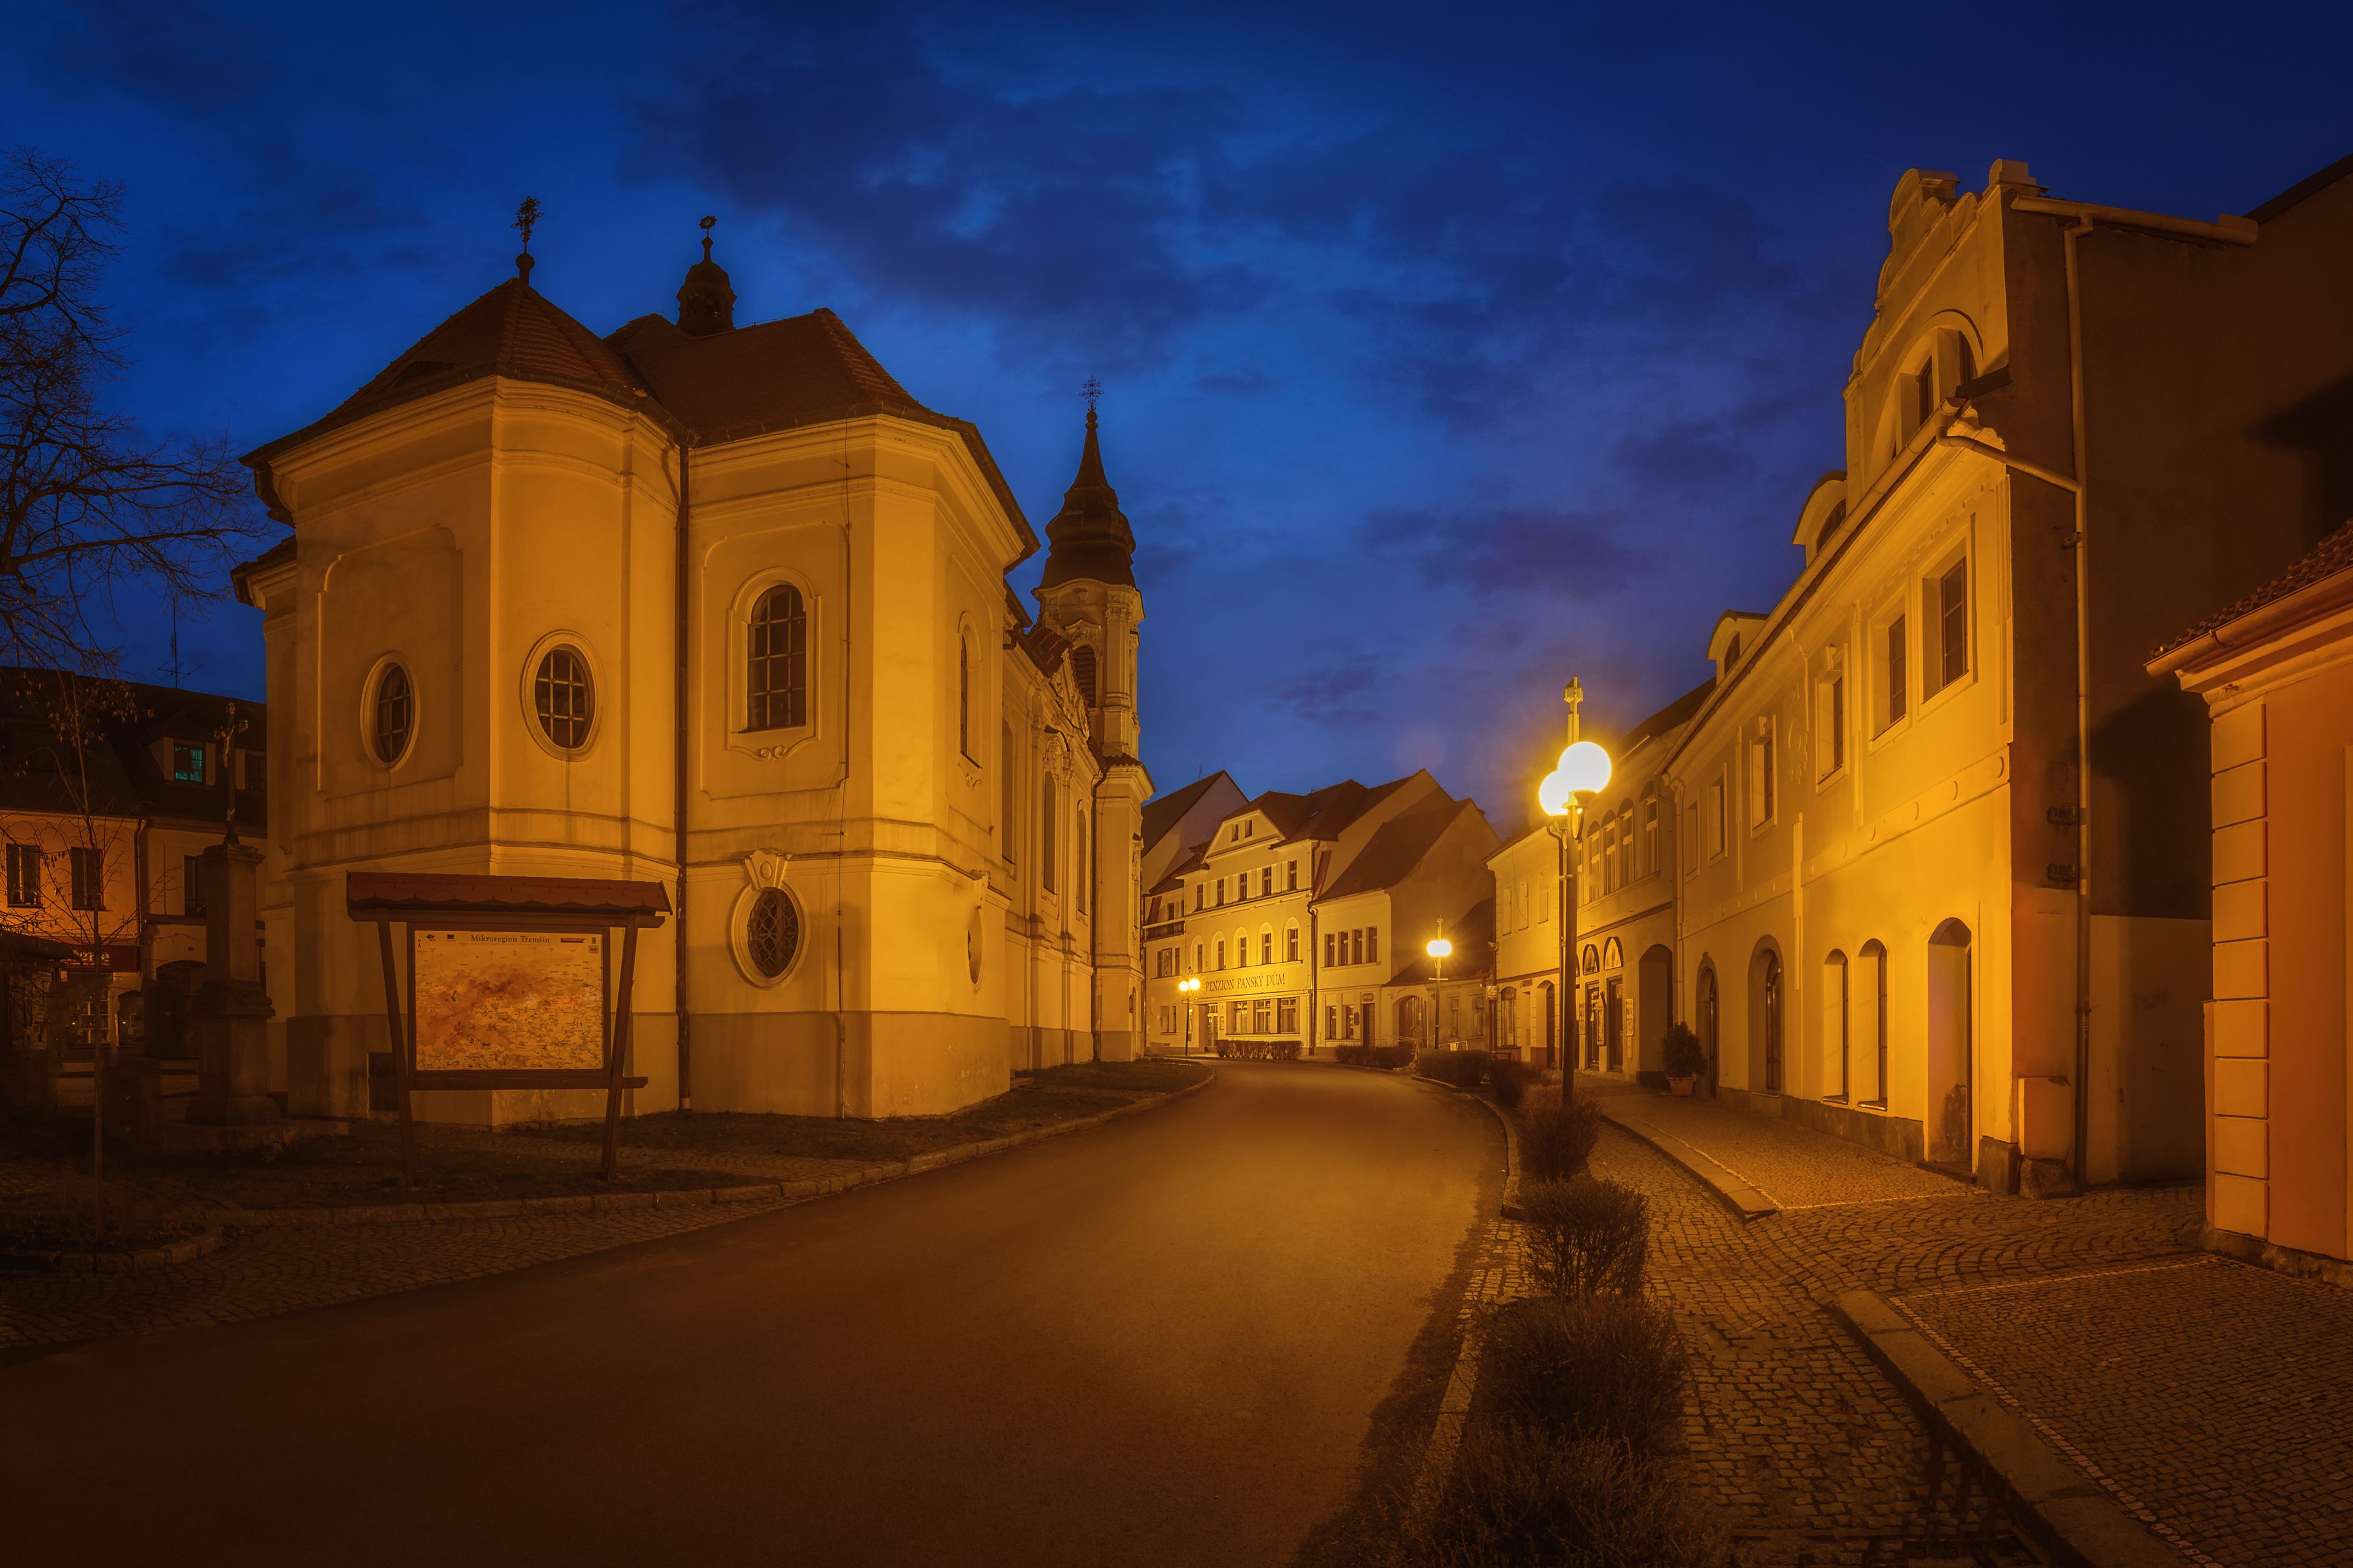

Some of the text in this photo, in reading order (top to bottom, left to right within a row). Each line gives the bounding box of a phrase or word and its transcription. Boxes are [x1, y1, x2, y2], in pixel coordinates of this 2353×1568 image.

[471, 934, 517, 944] Mikroregion
[520, 935, 550, 944] Třemšín
[1205, 971, 1286, 992] PENZION PANSKÝ DŮM
